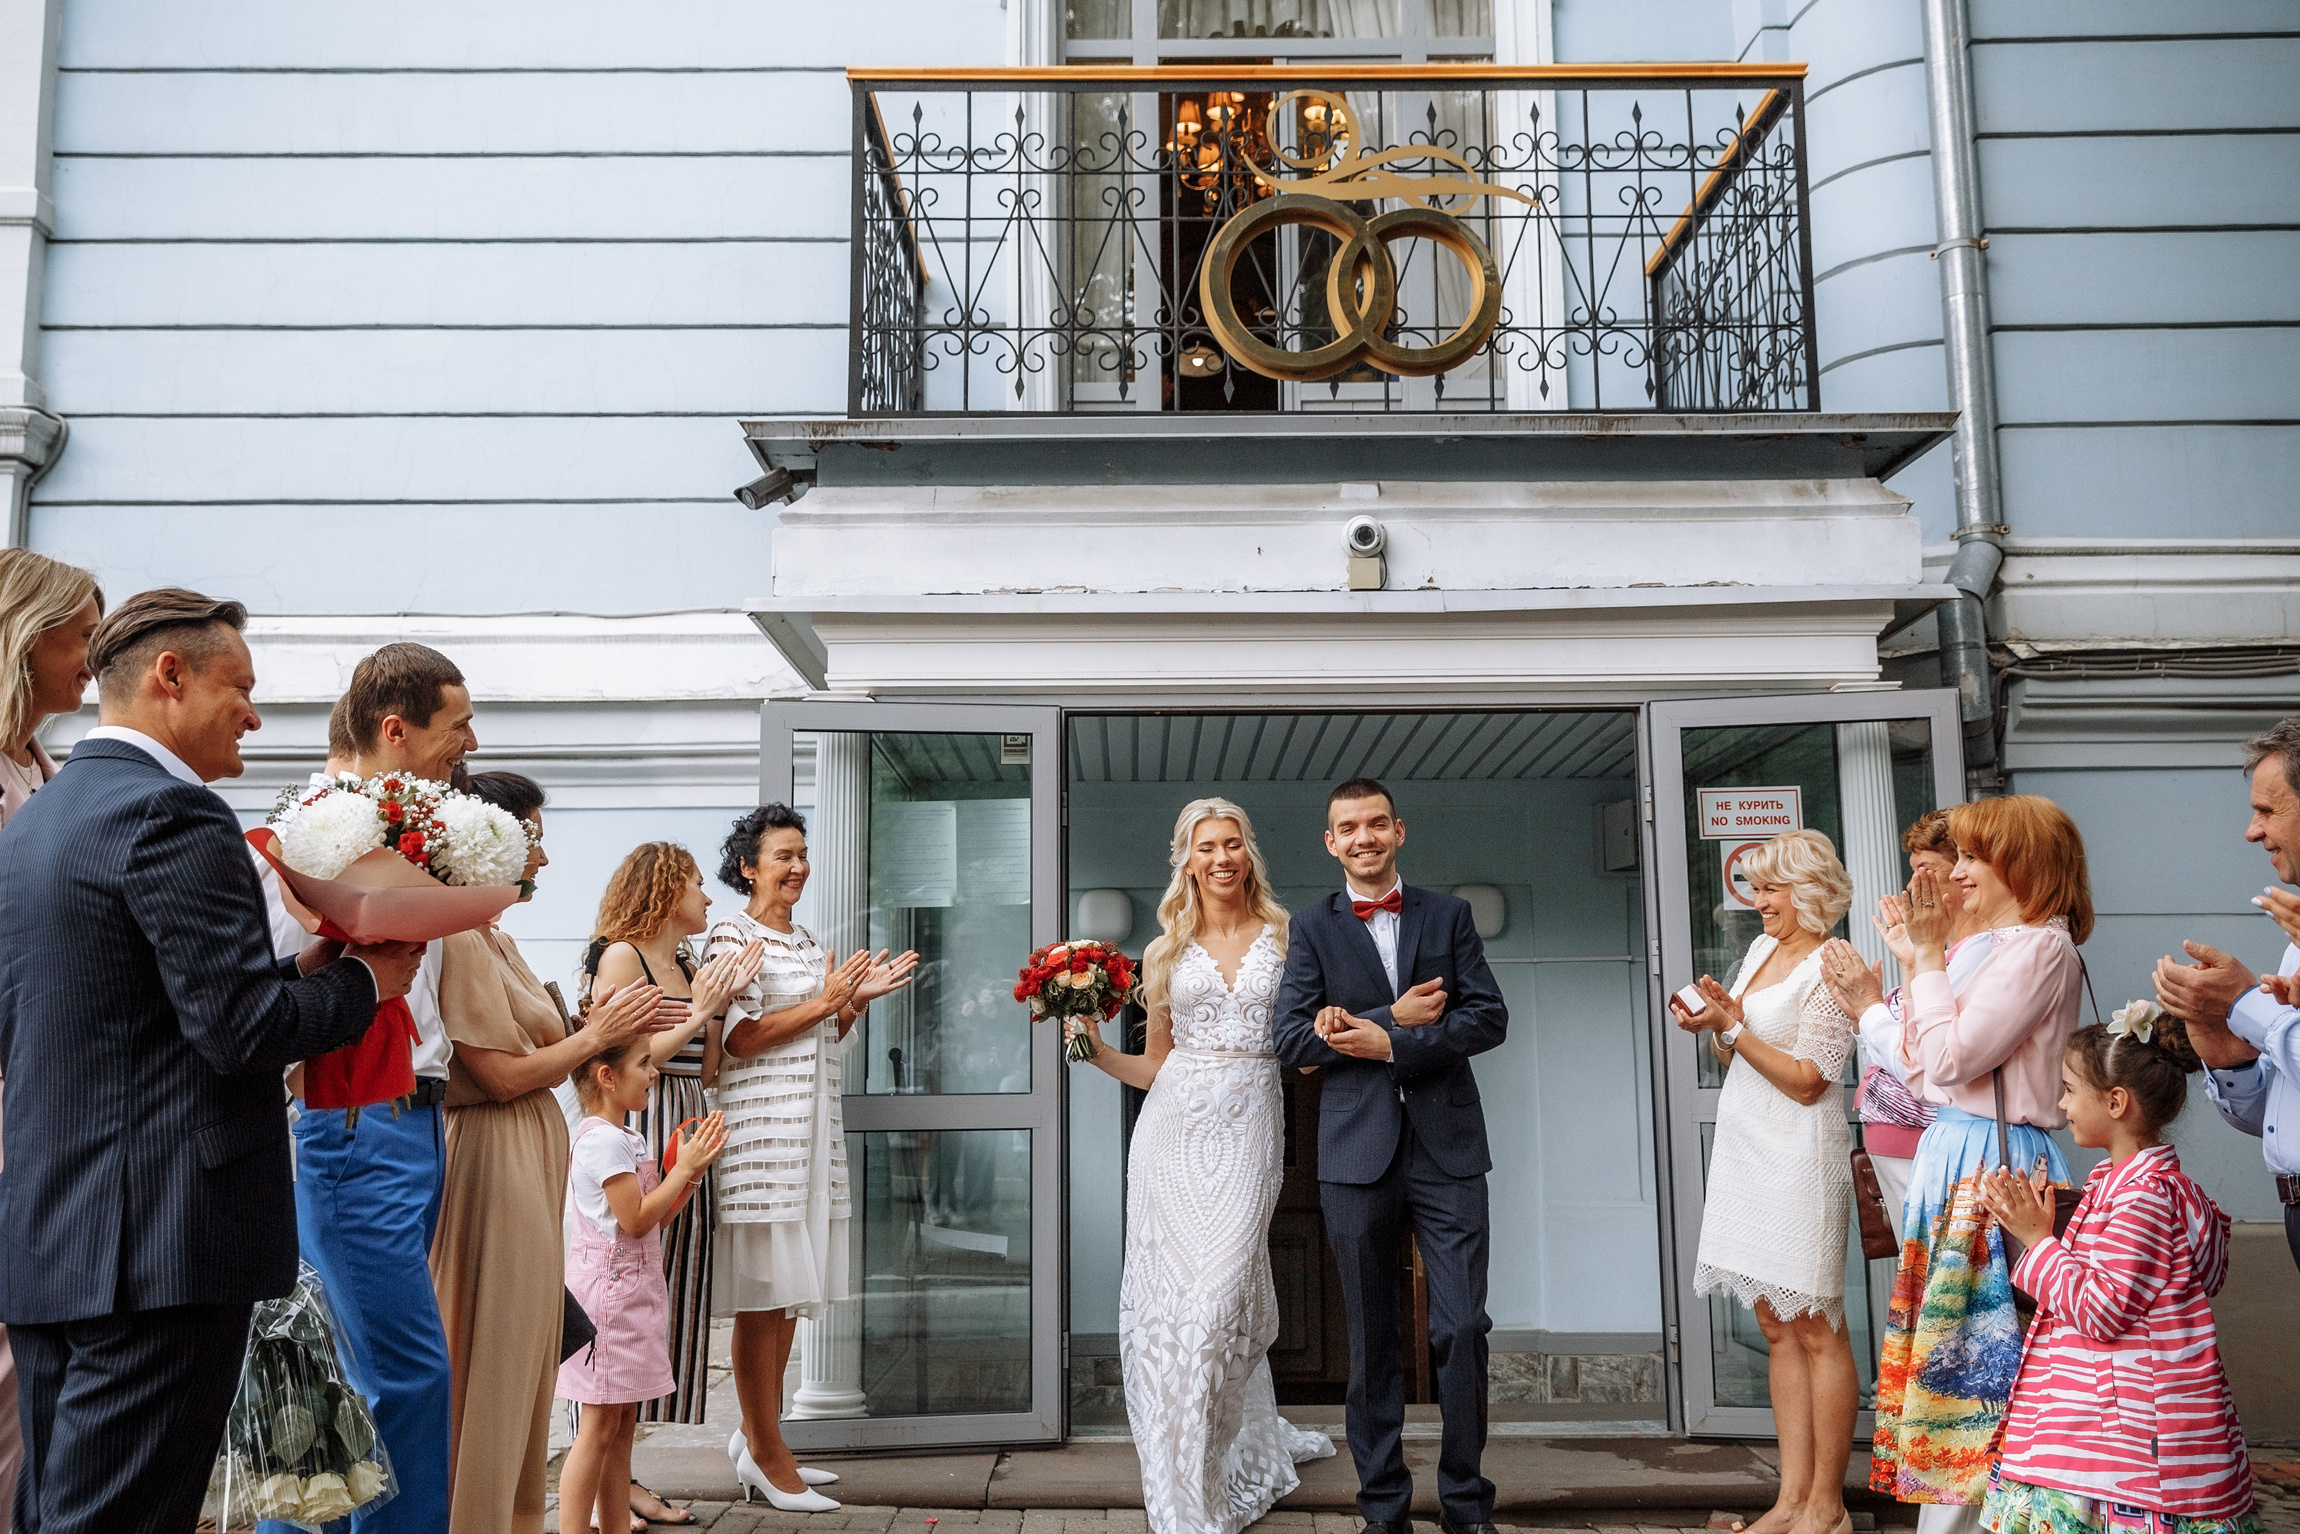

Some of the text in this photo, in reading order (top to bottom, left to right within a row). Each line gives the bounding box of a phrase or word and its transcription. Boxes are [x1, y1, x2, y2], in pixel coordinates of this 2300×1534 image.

[1716, 800, 1784, 811] НЕ КУРИТЬ
[1711, 815, 1791, 826] NO SMOKING
